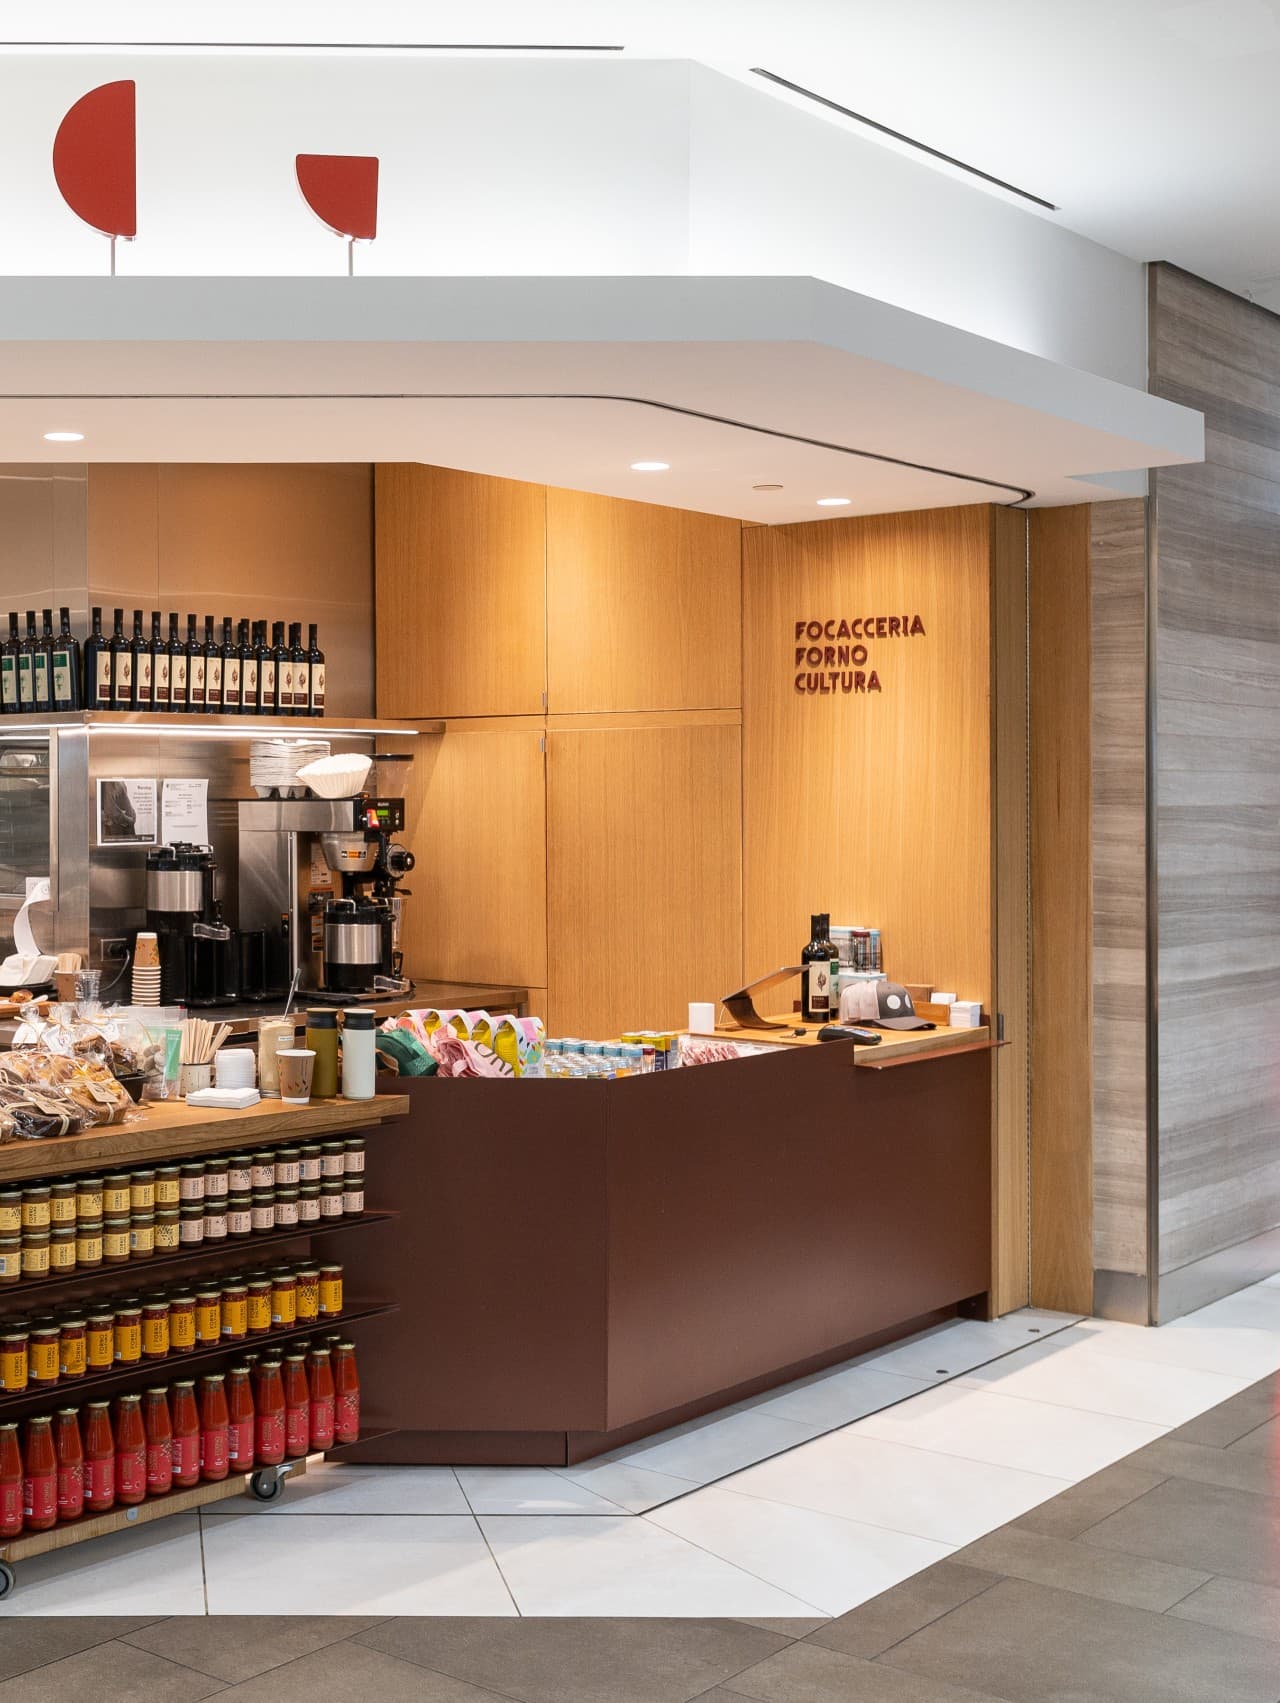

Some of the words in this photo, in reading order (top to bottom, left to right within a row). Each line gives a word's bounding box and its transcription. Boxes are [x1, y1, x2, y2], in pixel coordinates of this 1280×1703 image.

[795, 615, 926, 641] FOCACCERIA
[795, 645, 867, 667] FORNO
[795, 670, 882, 694] CULTURA
